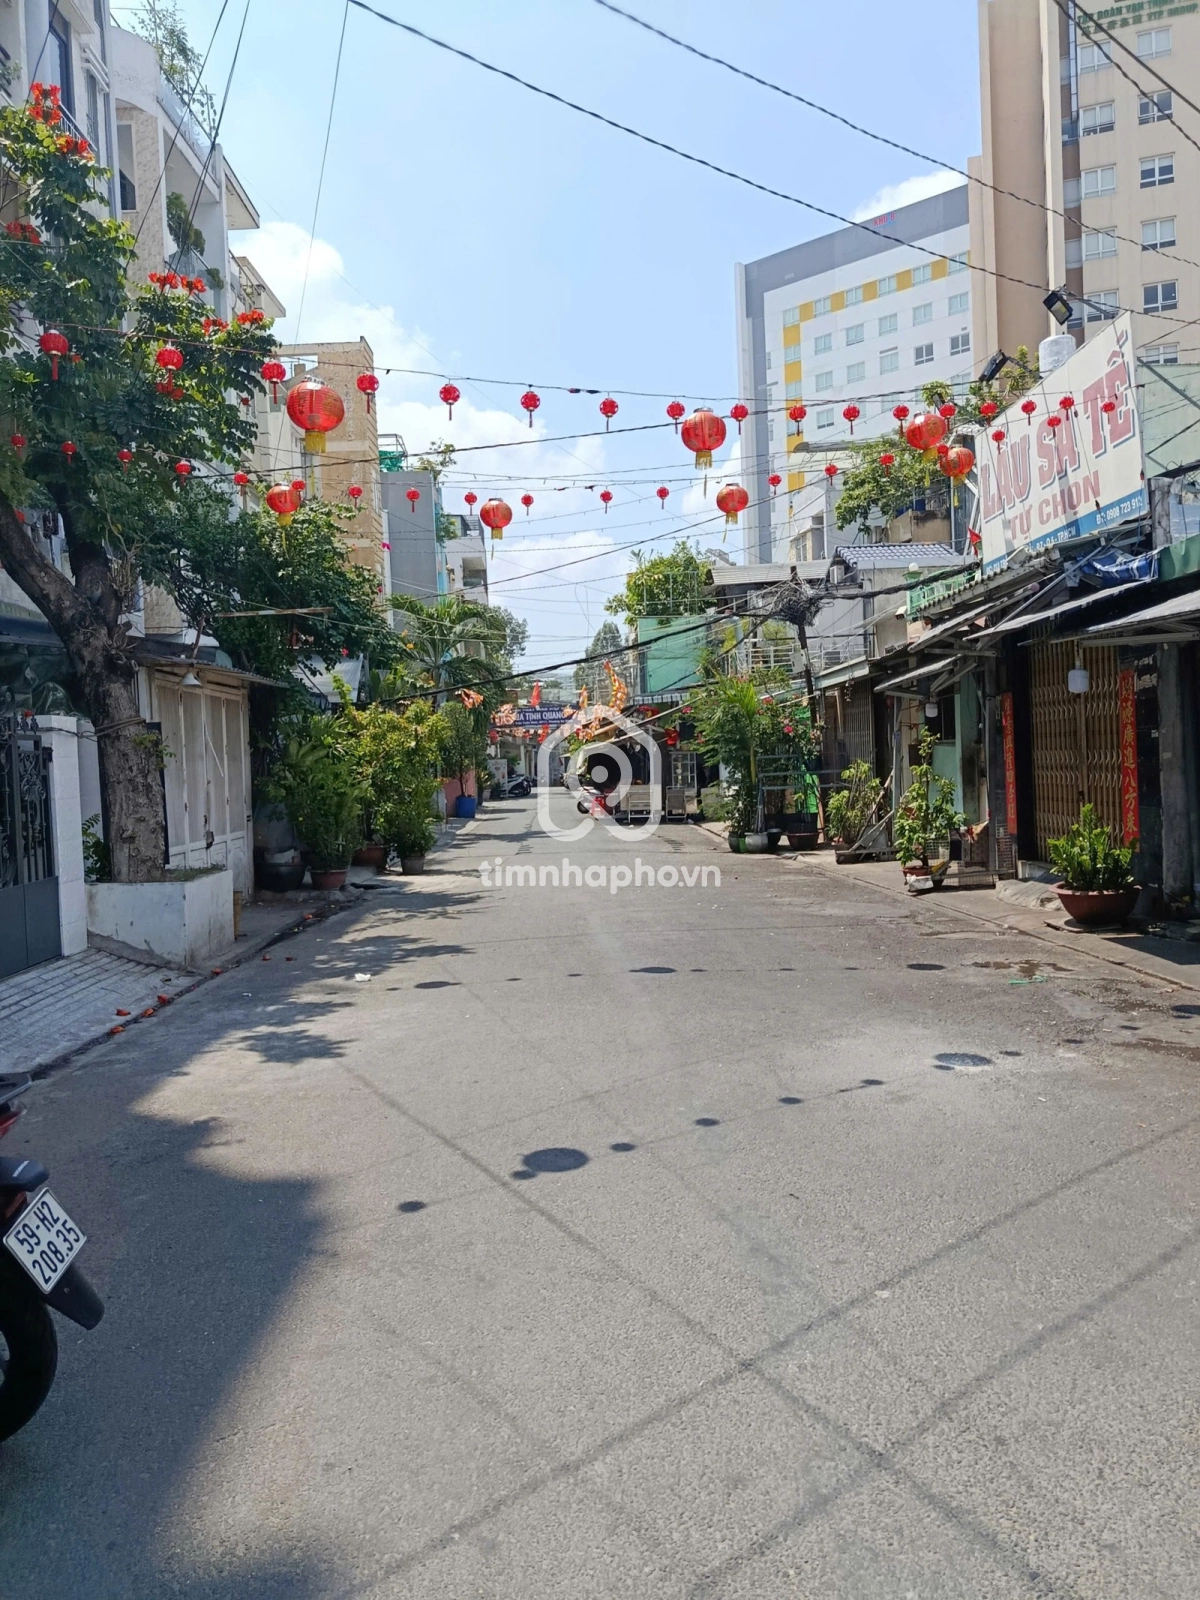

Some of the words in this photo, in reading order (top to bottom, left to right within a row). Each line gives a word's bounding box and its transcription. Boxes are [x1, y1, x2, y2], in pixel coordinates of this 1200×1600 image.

[1036, 406, 1079, 489] SA
[1083, 330, 1135, 457] TẾ
[1010, 504, 1033, 541] TỰ
[1038, 470, 1100, 526] CHỌN
[1106, 506, 1120, 521] 0908
[1120, 501, 1131, 515] 723
[14, 1200, 60, 1254] 59-H2
[32, 1219, 80, 1285] 208.35
